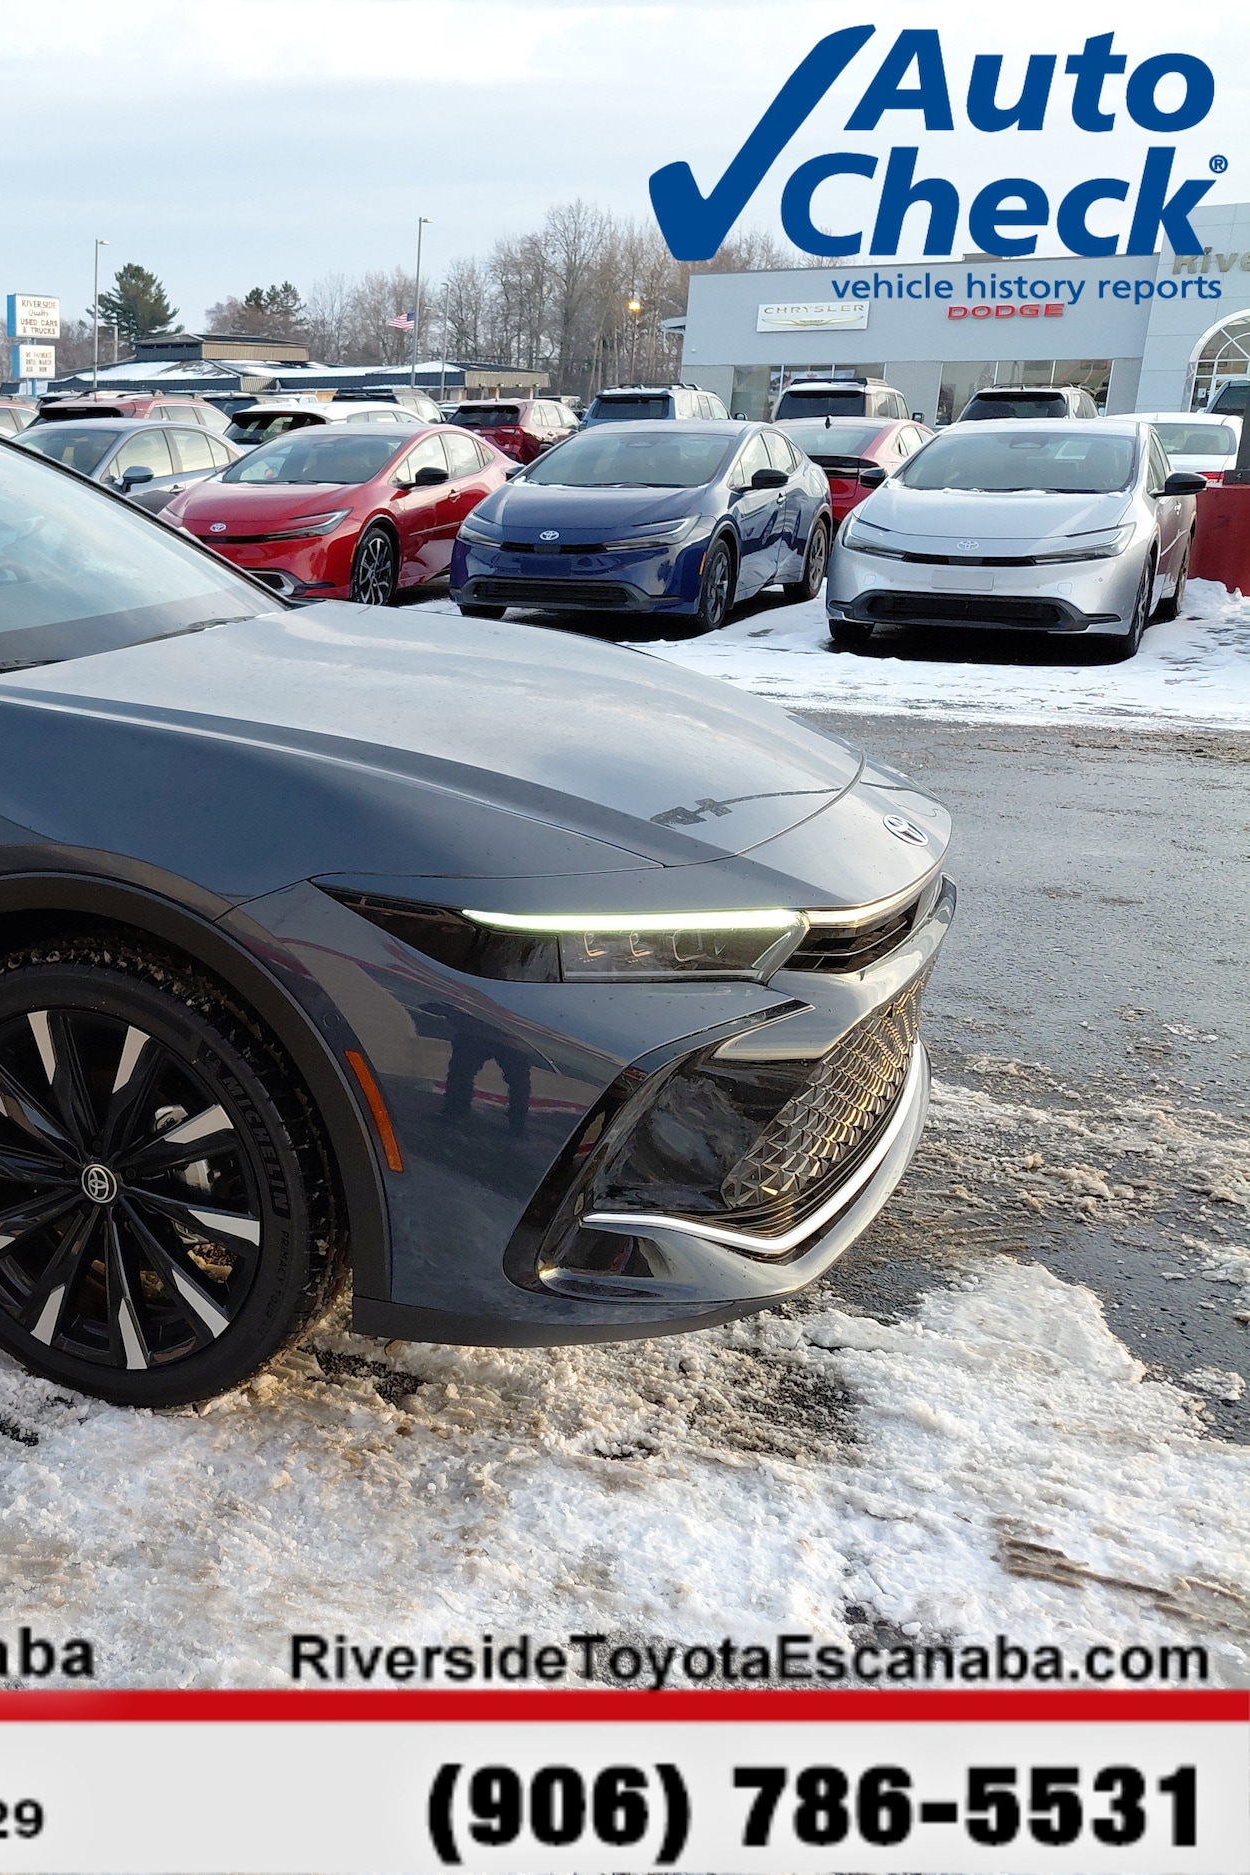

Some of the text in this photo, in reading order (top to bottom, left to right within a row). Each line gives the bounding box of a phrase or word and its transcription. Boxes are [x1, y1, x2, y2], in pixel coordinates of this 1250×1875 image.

[21, 299, 57, 310] RIVERSIDE
[763, 303, 865, 315] CHRYSLER
[28, 309, 49, 318] Quality
[947, 303, 1064, 320] DODGE
[20, 318, 58, 327] USED CARS
[31, 326, 56, 335] TRUCKS
[222, 1075, 291, 1212] MICHELIN
[277, 1229, 290, 1284] PRIMACY
[265, 1287, 282, 1318] TOUR
